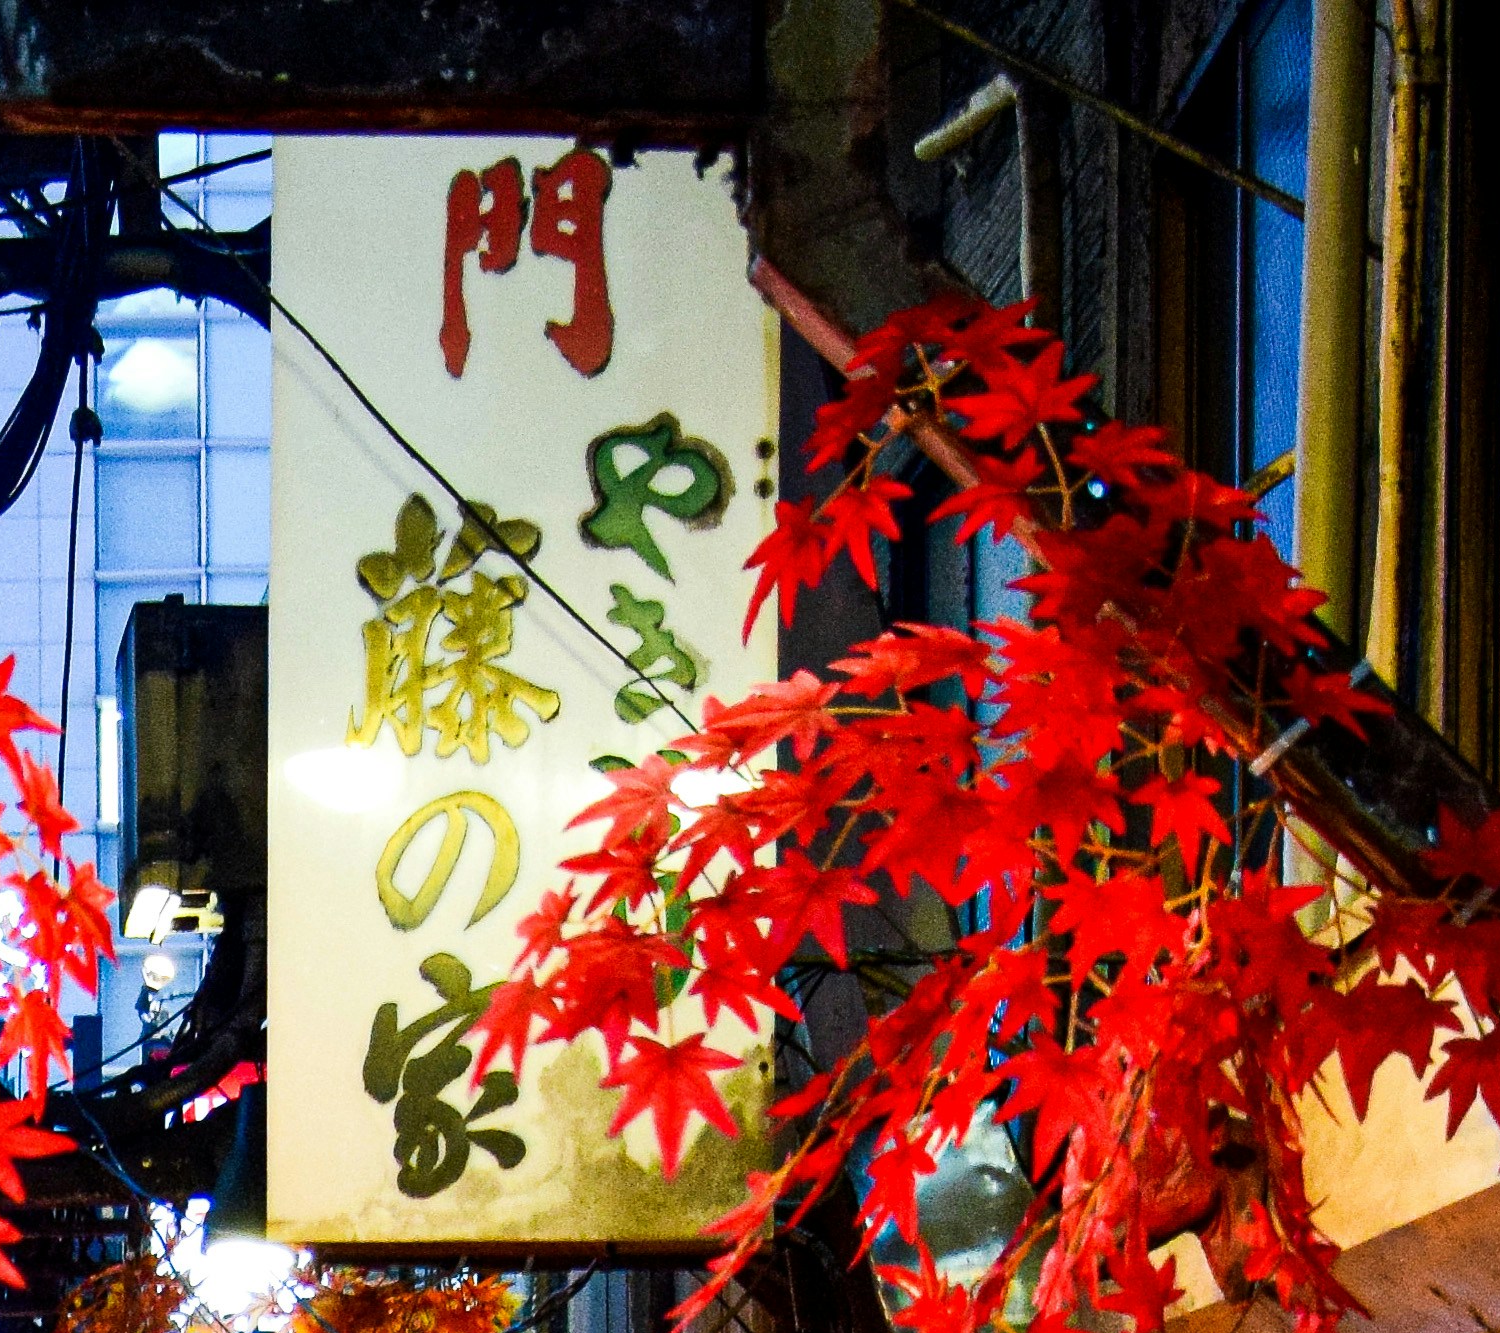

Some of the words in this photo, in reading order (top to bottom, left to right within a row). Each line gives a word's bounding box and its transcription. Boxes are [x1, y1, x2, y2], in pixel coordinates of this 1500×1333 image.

[438, 148, 616, 380] 門
[345, 492, 561, 1198] 藤の家
